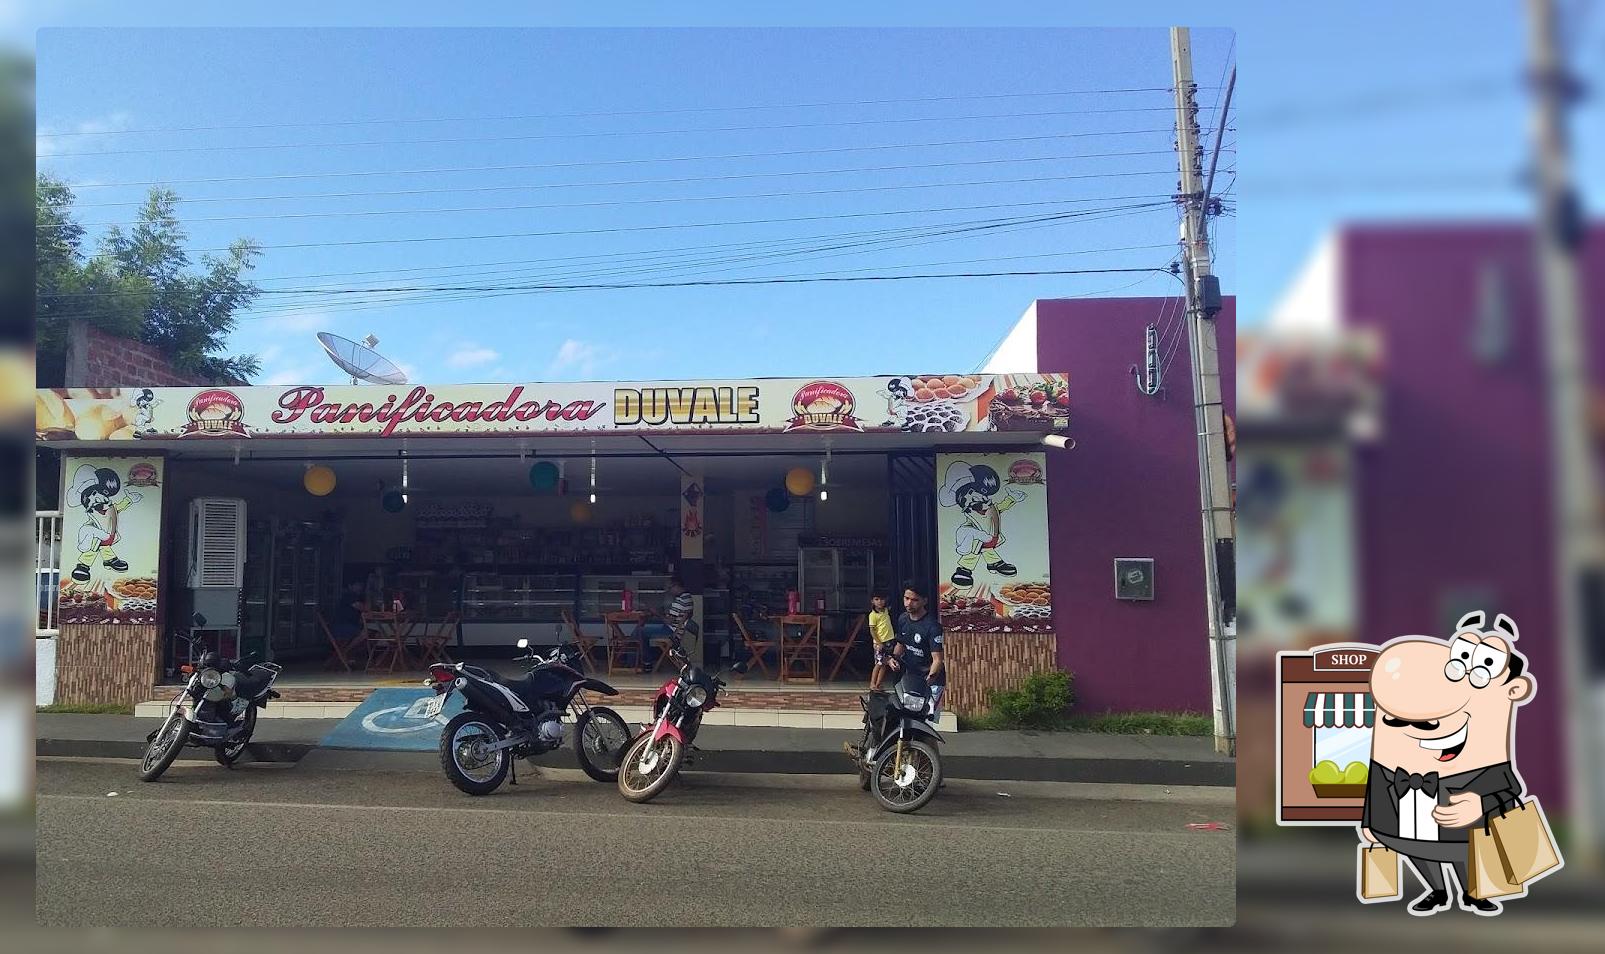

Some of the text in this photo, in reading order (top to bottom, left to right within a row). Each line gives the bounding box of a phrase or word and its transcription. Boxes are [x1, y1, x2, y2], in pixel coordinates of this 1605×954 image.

[271, 386, 760, 436] Panificadora DUVALE
[803, 413, 845, 424] DUVALE
[197, 419, 235, 430] DUVALE
